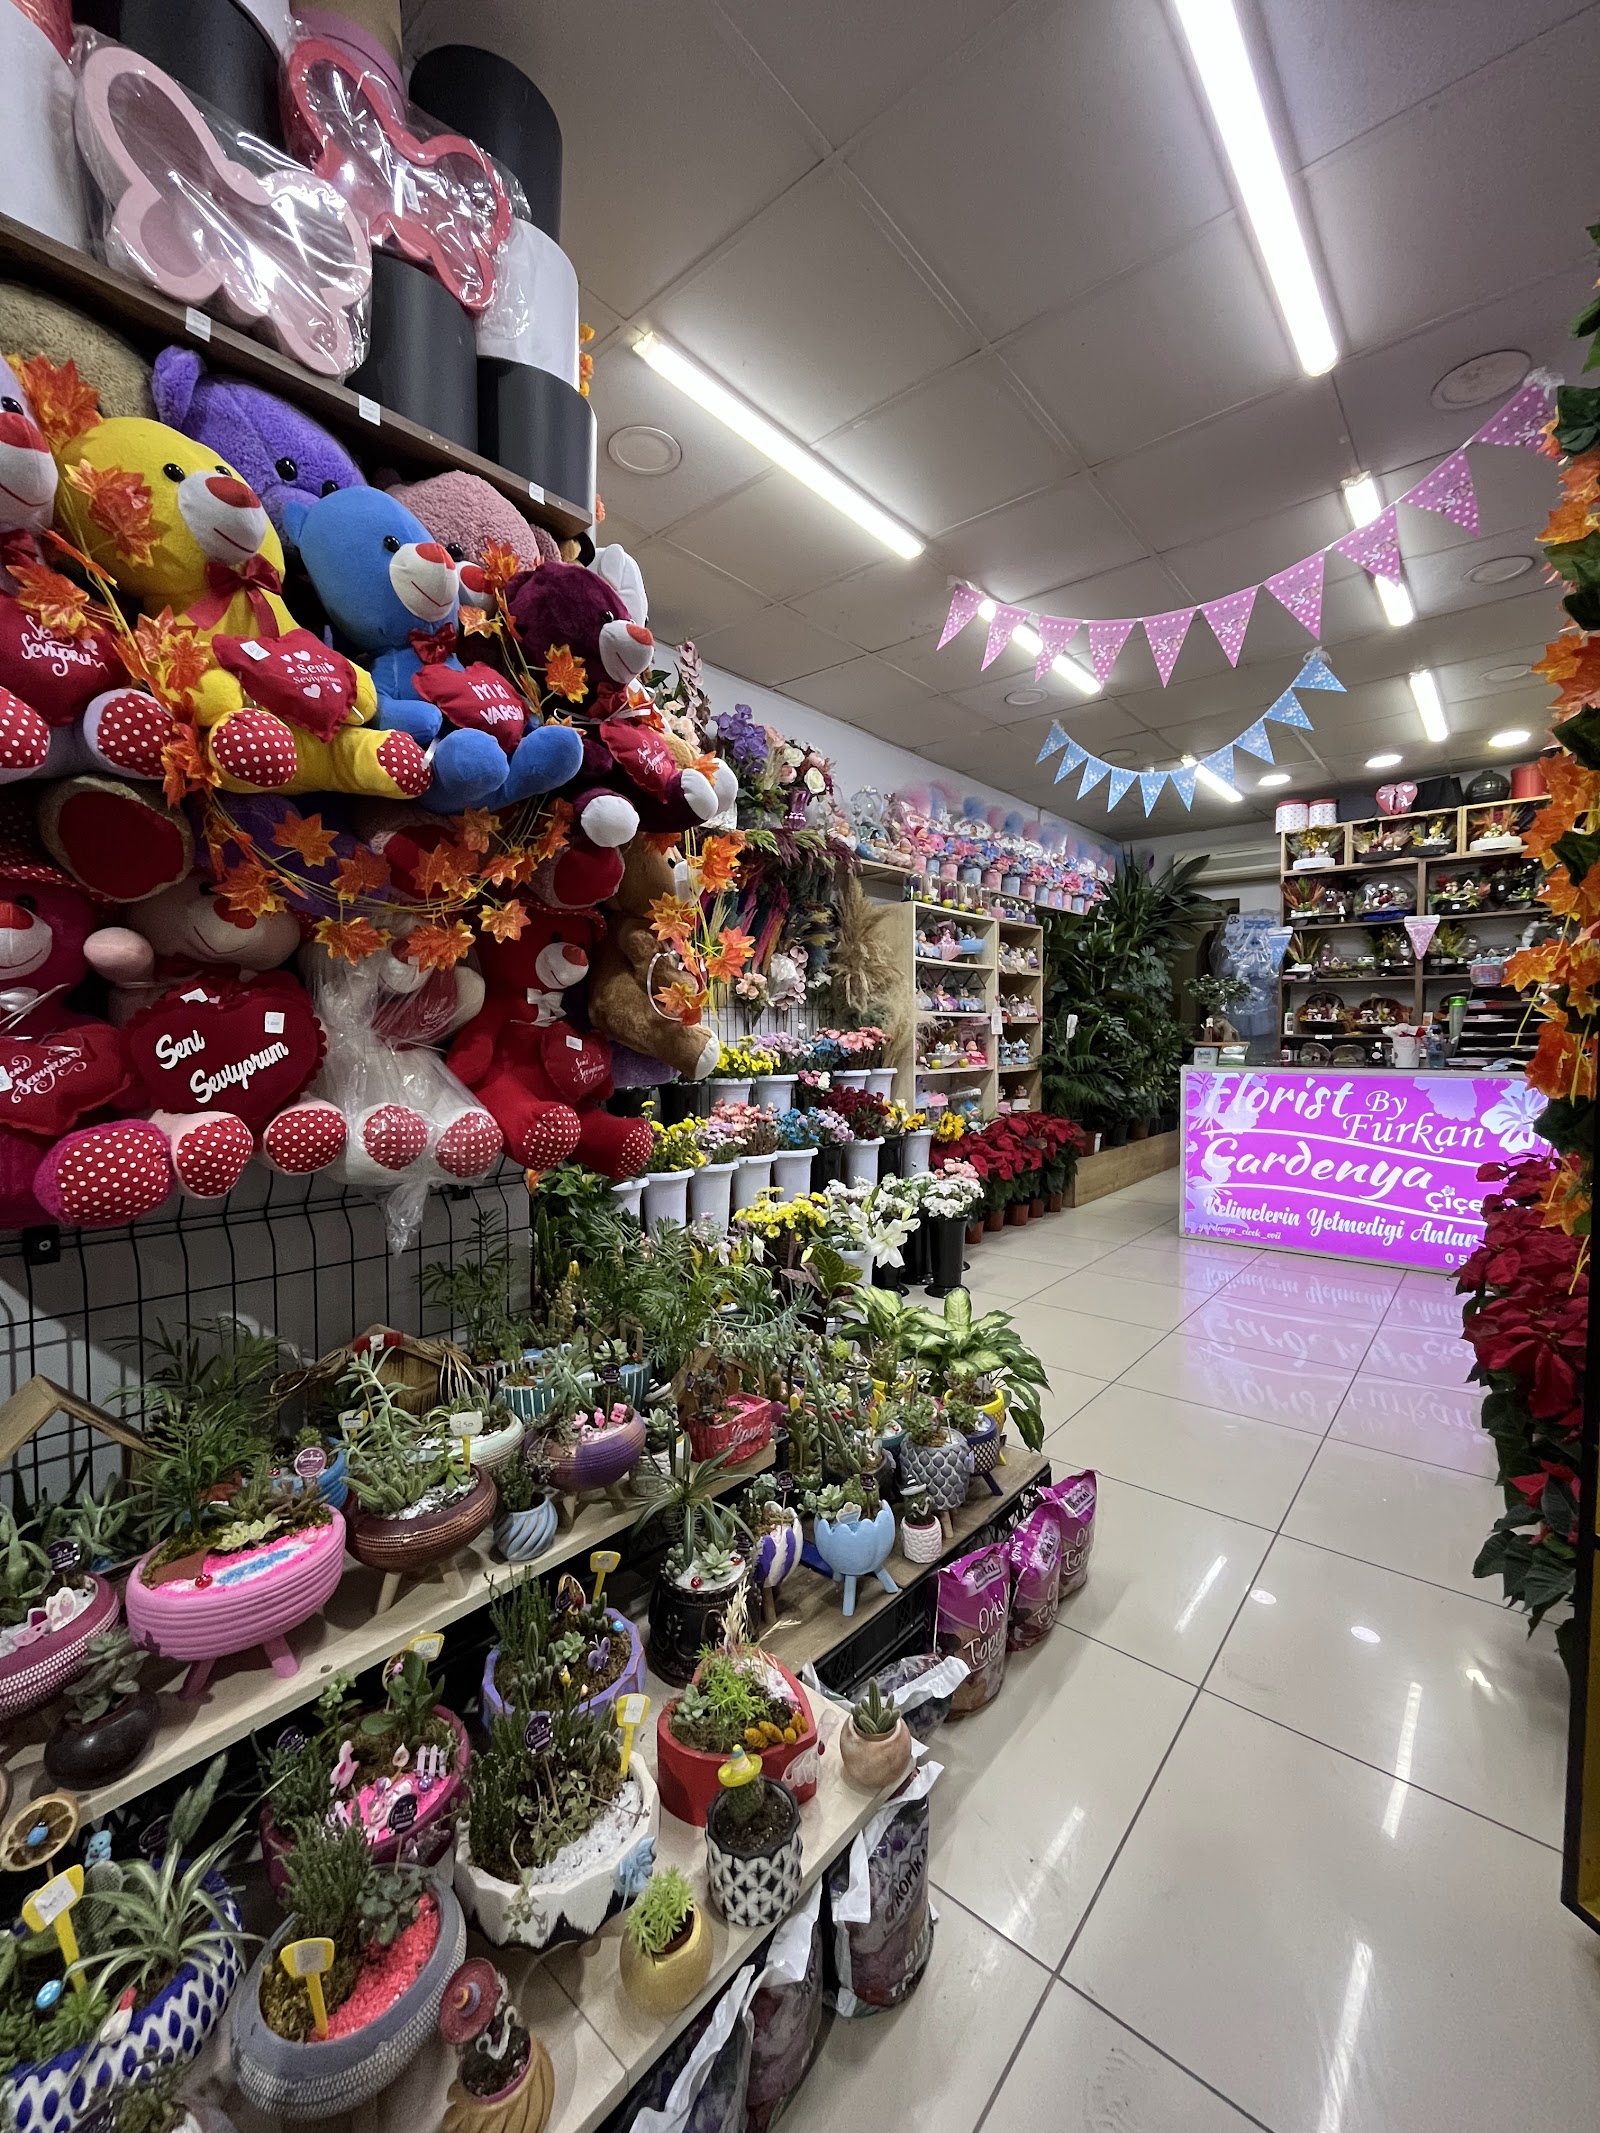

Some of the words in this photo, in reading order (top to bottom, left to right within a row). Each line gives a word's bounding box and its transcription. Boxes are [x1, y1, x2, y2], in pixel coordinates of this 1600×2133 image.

[297, 661, 329, 675] Seni
[9, 1054, 33, 1077] eni
[155, 1029, 206, 1070] Seni
[189, 1041, 290, 1104] Seviyorum
[1204, 1073, 1355, 1120] Florist
[1365, 1090, 1408, 1121] By
[1342, 1112, 1486, 1154] Furkan
[1204, 1137, 1434, 1201] Gardenya
[1203, 1195, 1301, 1227] Kelimelerin
[1306, 1207, 1405, 1247] Yetmedigi
